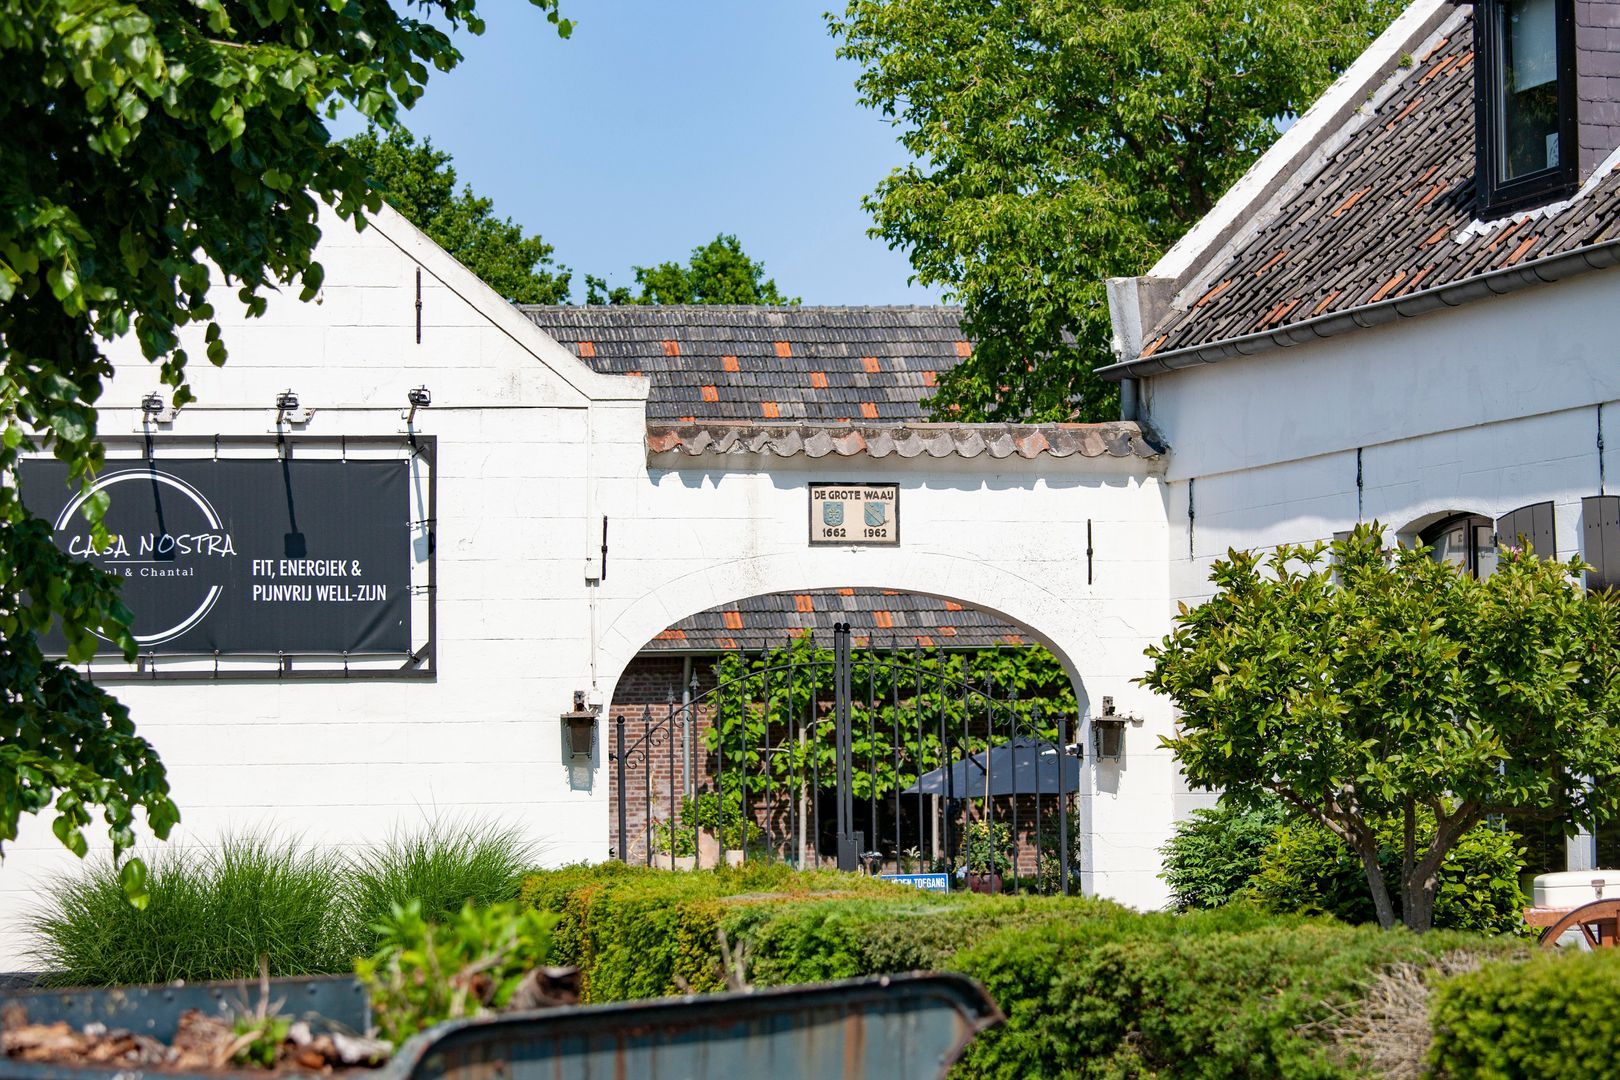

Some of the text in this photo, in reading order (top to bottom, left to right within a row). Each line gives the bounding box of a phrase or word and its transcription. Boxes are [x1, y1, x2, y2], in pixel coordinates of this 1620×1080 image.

[814, 490, 826, 500] DE
[829, 490, 861, 500] GROTE
[823, 528, 846, 538] 1662
[863, 528, 887, 538] 1962
[139, 533, 237, 558] NOSTRA
[125, 567, 133, 577] &
[140, 567, 194, 577] Chantal
[252, 559, 362, 579] FIT, ENERGIEK &
[252, 584, 387, 602] PIJNVRIJ WELL-ZIJN
